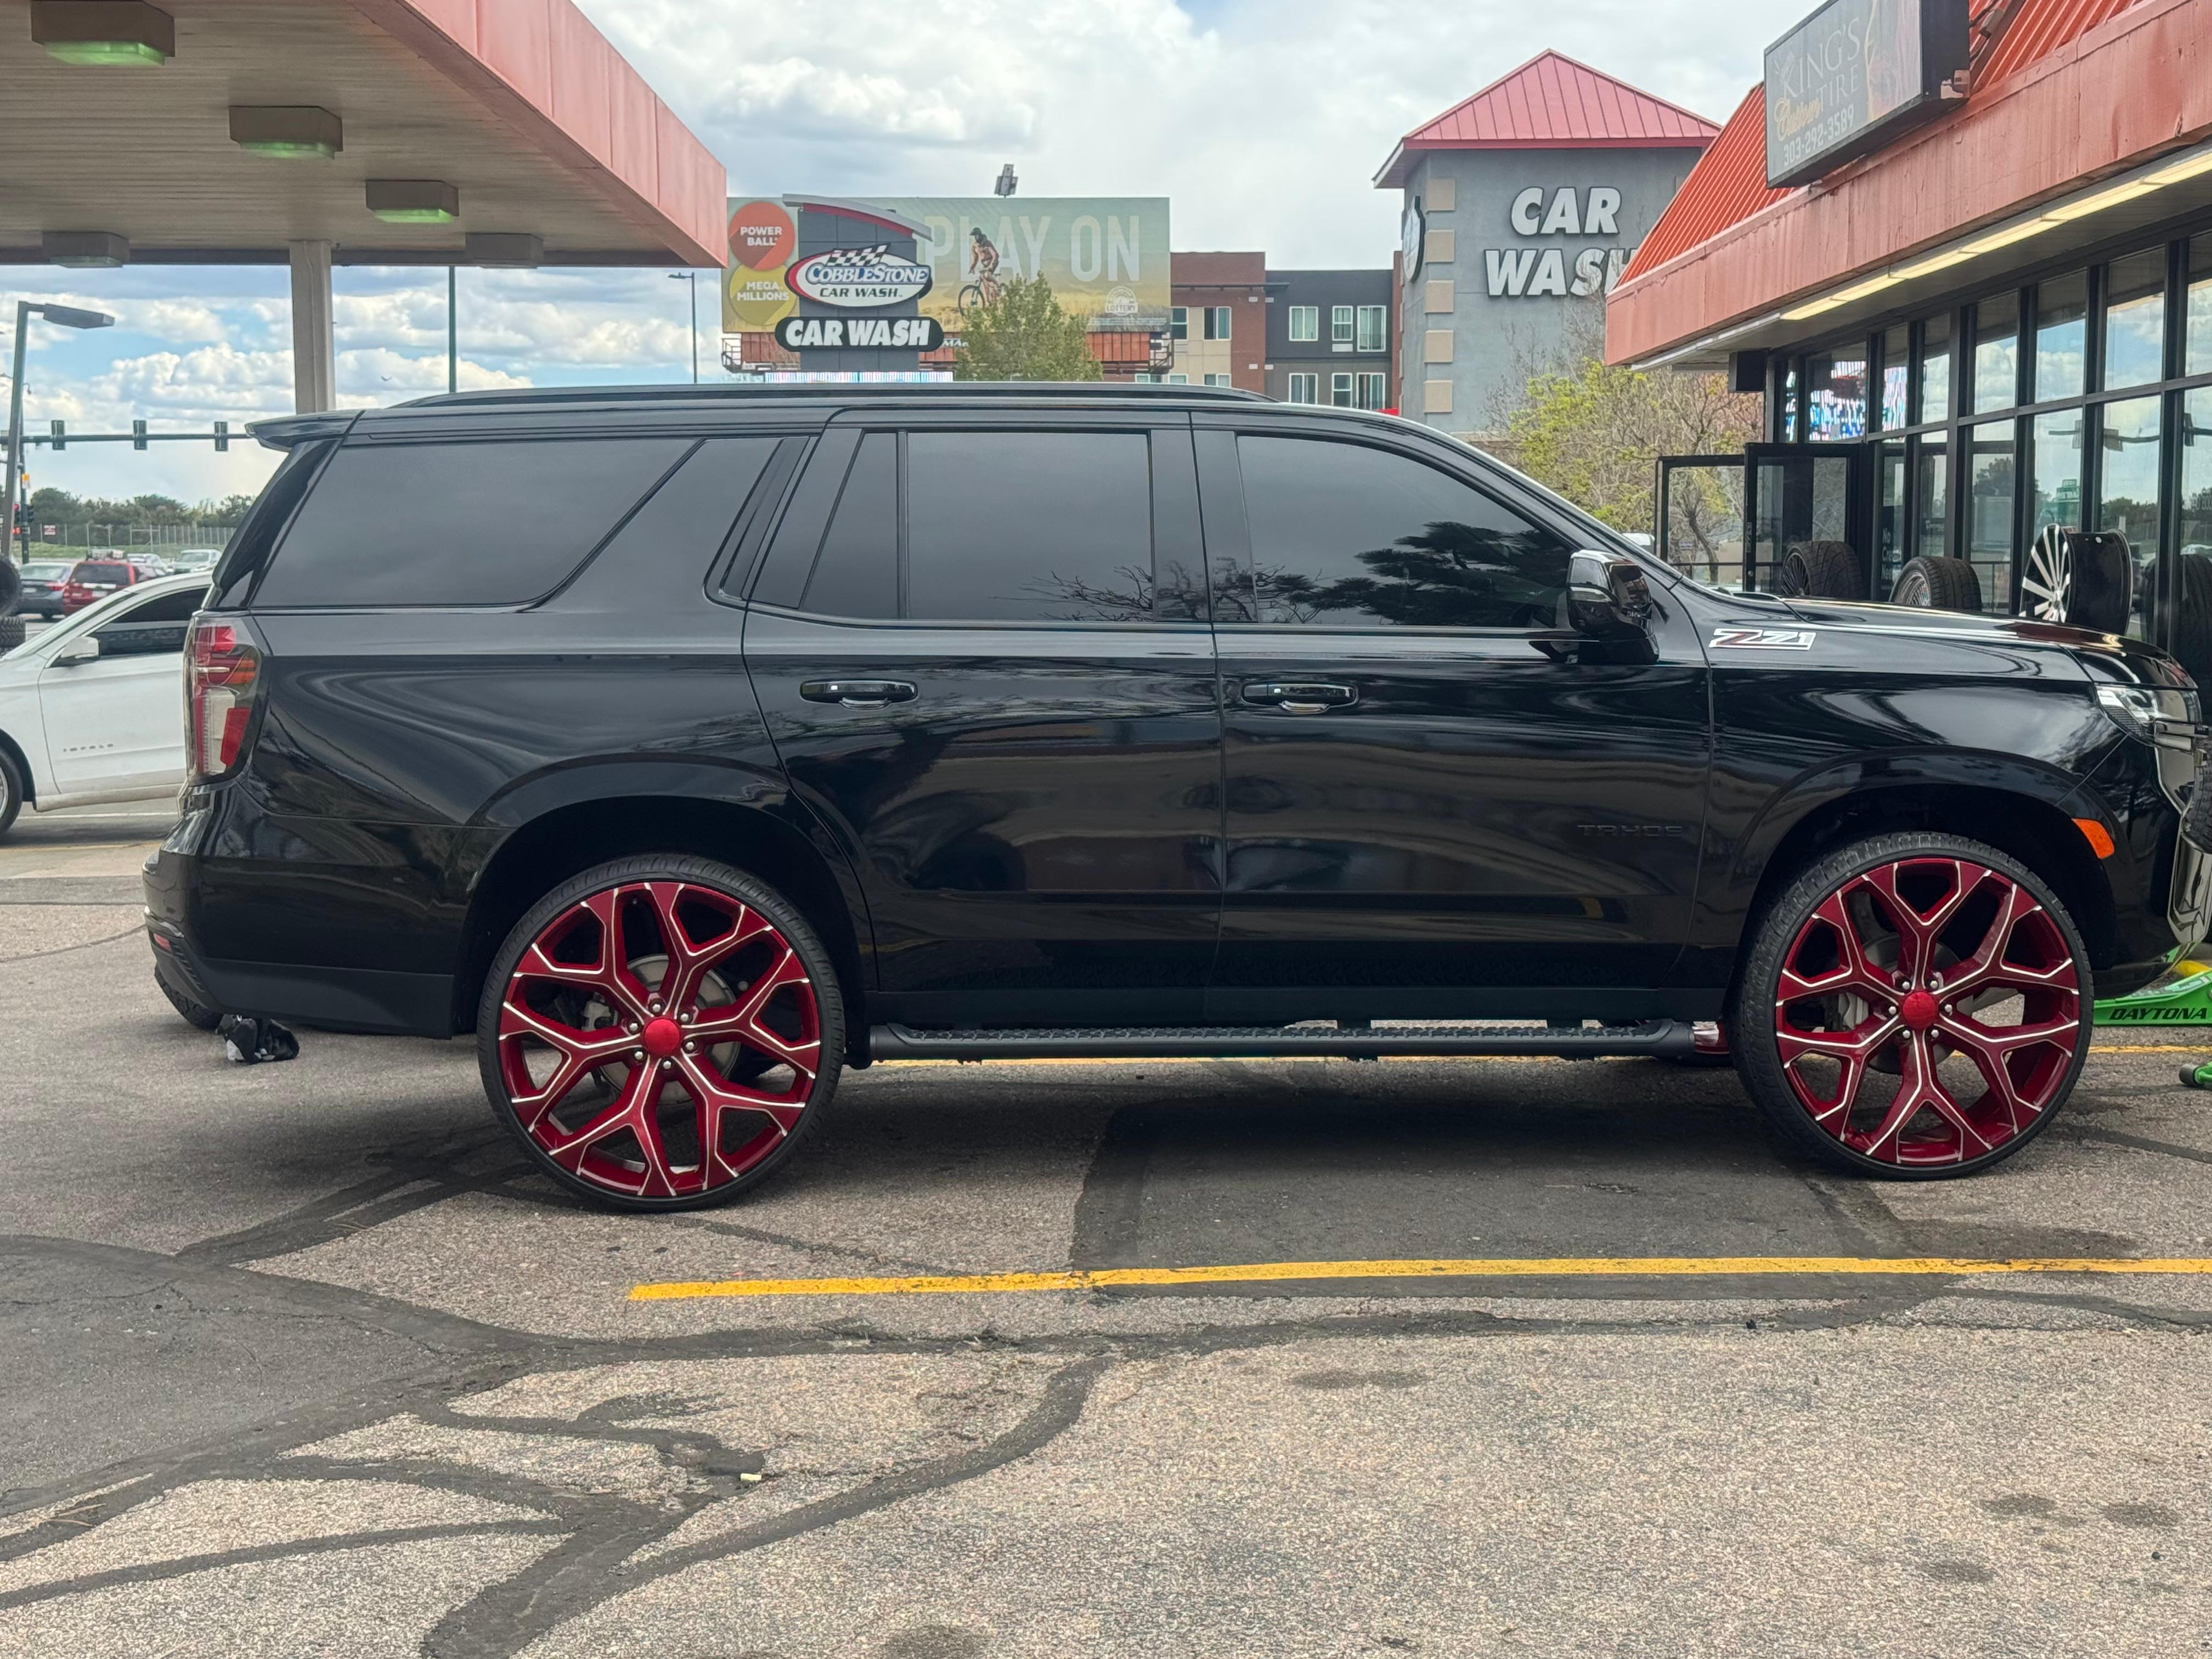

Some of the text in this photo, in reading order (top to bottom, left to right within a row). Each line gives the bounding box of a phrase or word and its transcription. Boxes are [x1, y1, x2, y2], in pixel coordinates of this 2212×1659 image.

[1782, 18, 1860, 100] KING'S
[1816, 64, 1859, 111] TIRE
[1783, 103, 1854, 166] 303-292-3589
[1510, 186, 1622, 236] CAR
[740, 226, 782, 236] POWER
[747, 237, 777, 246] BALL
[925, 215, 1140, 282] PLAY ON
[746, 281, 780, 290] MEGA
[820, 287, 899, 297] CAR WASH
[737, 291, 790, 301] MILLIONS
[1106, 304, 1136, 312] LOTTERY
[786, 319, 930, 347] CAR WASH
[1708, 628, 1816, 650] Z71
[1577, 825, 1682, 837] TAHOE
[2109, 1007, 2208, 1020] DAYTONA
